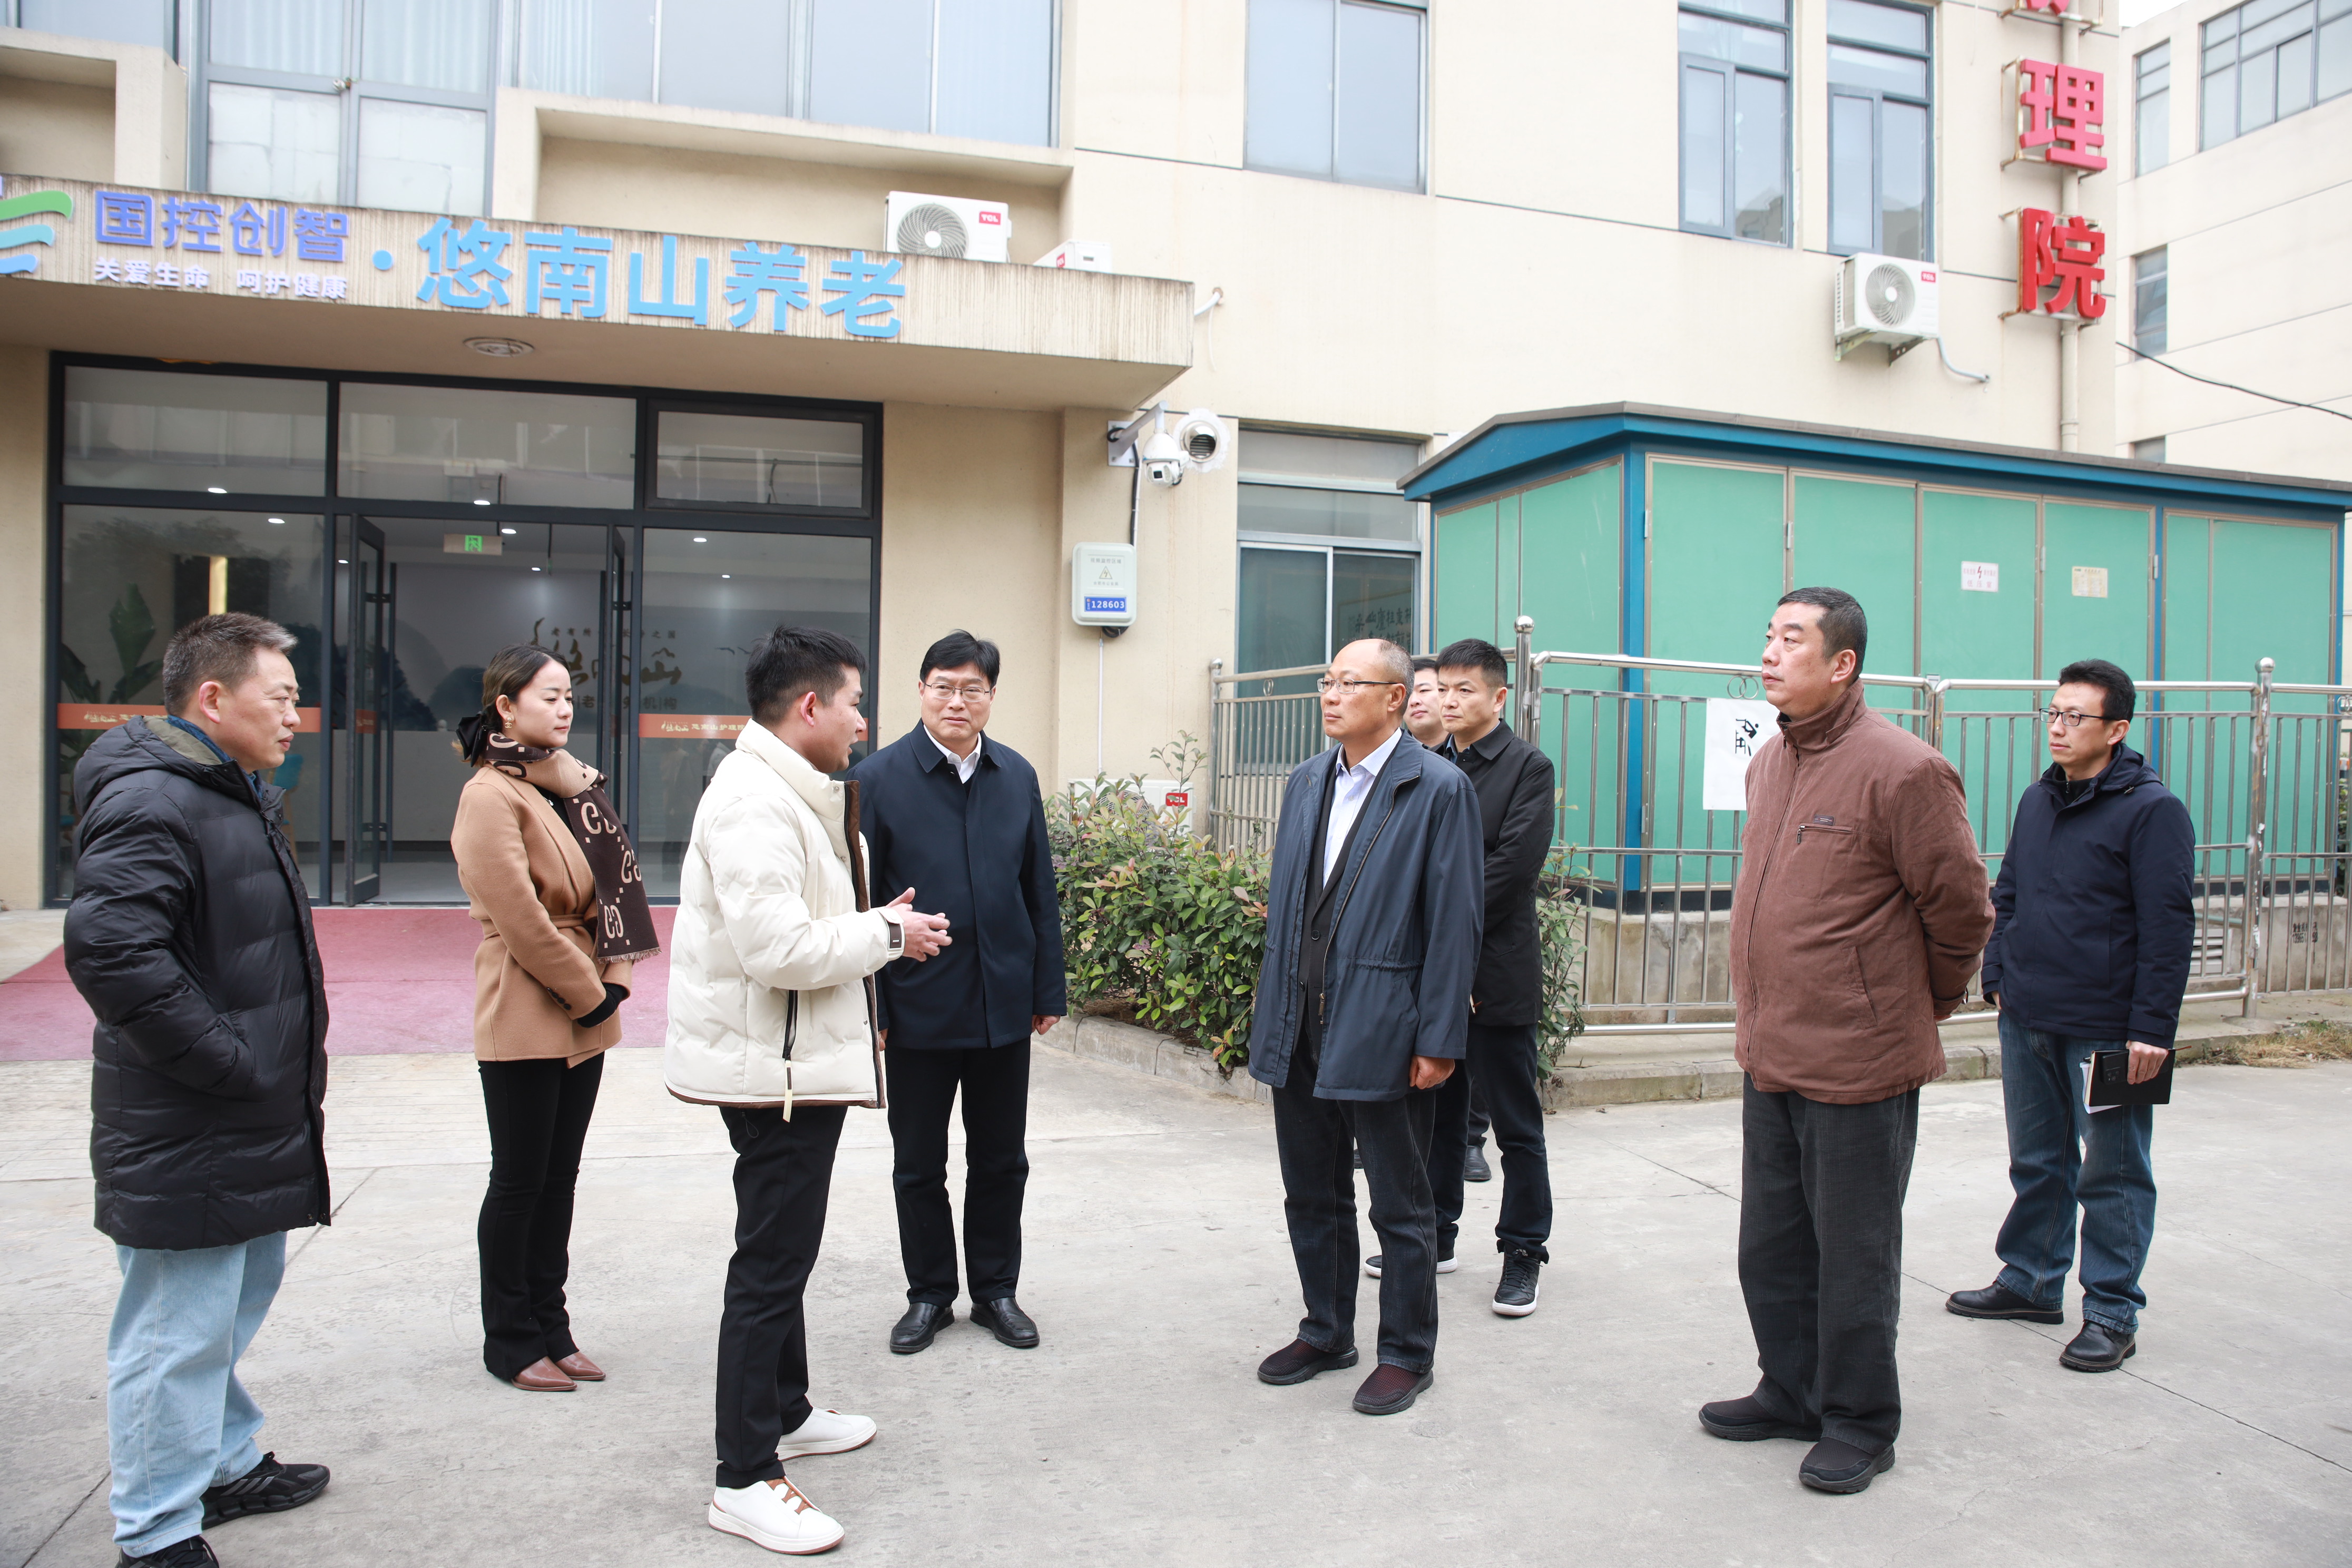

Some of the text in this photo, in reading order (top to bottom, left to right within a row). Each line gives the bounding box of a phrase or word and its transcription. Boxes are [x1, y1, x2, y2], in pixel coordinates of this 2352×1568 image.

[2020, 0, 2107, 319] 理院
[981, 213, 998, 223] TCL
[93, 256, 348, 300] 关爱生命 呵护健康
[95, 190, 350, 262] 国控创智
[417, 216, 906, 338] 悠南山养老
[1091, 600, 1125, 609] 128603
